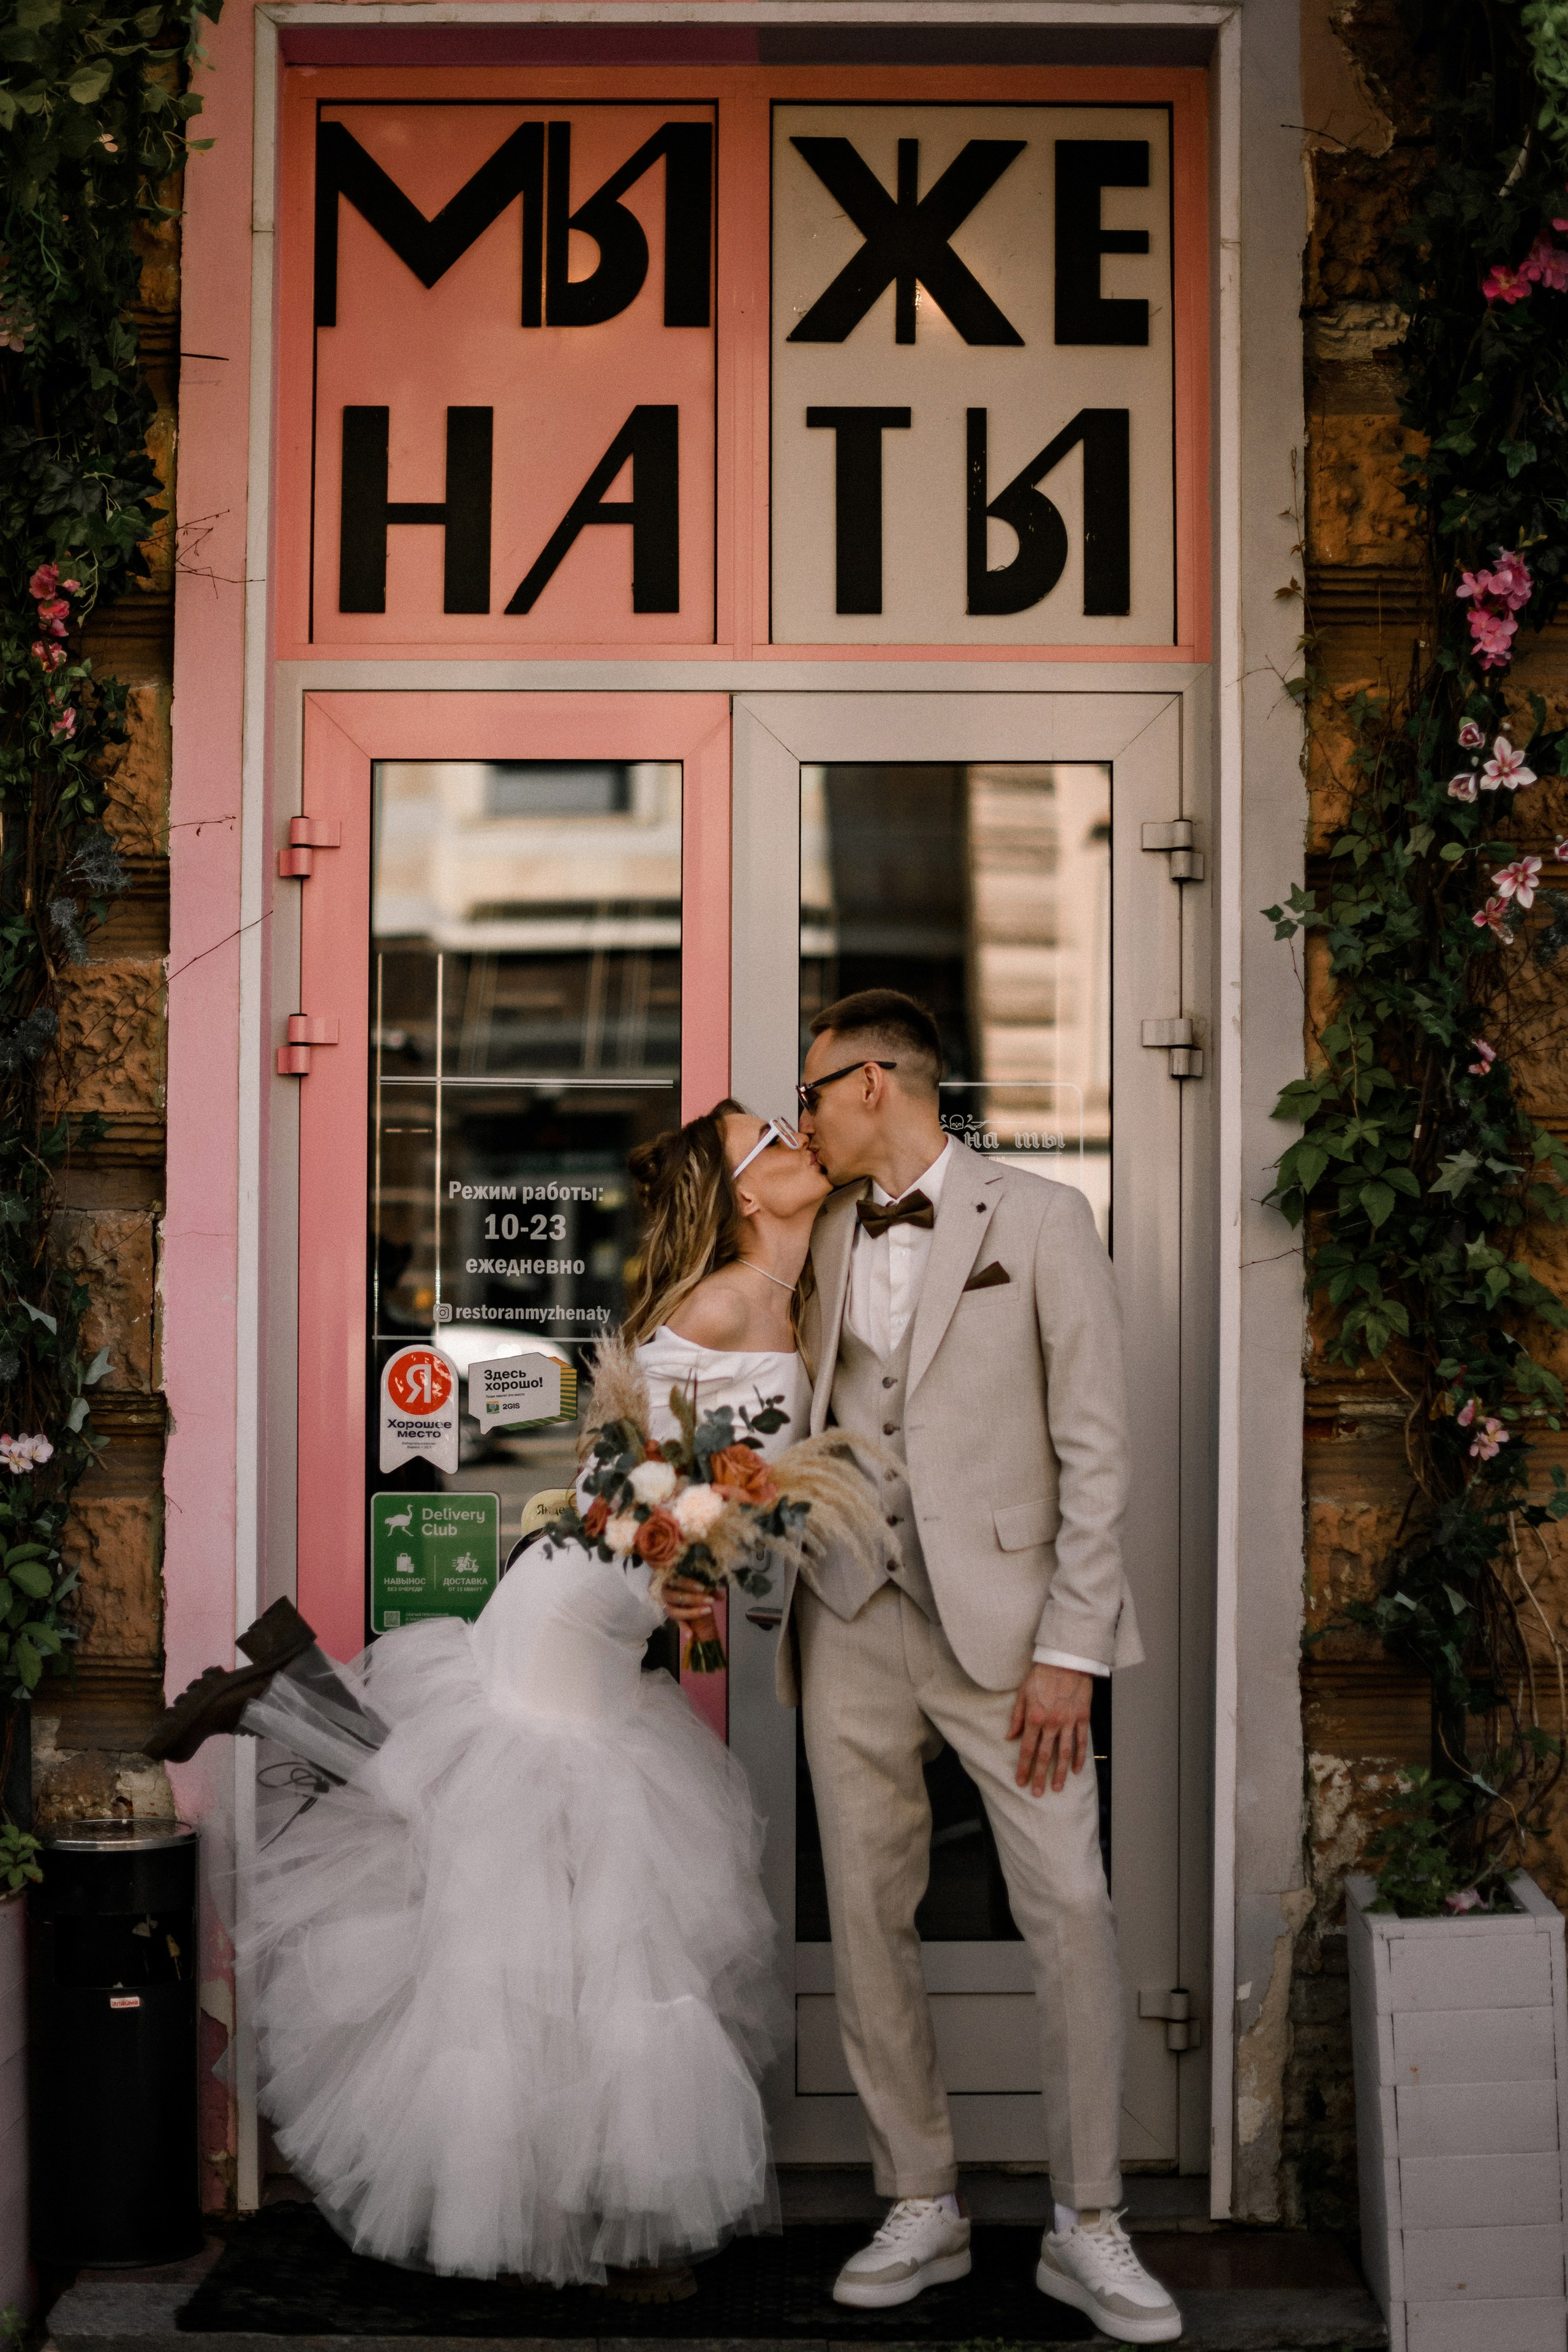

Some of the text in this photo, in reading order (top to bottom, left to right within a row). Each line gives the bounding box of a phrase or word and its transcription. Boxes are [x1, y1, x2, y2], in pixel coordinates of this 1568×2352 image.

[314, 121, 1150, 345] МЫ ЖЕ
[338, 404, 1130, 616] НА ТЫ
[963, 1131, 1000, 1149] на
[449, 1181, 603, 1204] Режим работы:
[484, 1213, 567, 1240] 10-23
[466, 1258, 586, 1276] ежедневно
[456, 1305, 611, 1324] restoranmyzhenaty
[405, 1363, 432, 1403] Я
[484, 1369, 527, 1381] Здесь
[485, 1376, 543, 1392] хорошо!
[387, 1419, 452, 1430] Хорошее
[422, 1508, 485, 1523] Delivery
[422, 1523, 458, 1536] Club
[443, 1577, 488, 1586] ДОСТАВКА
